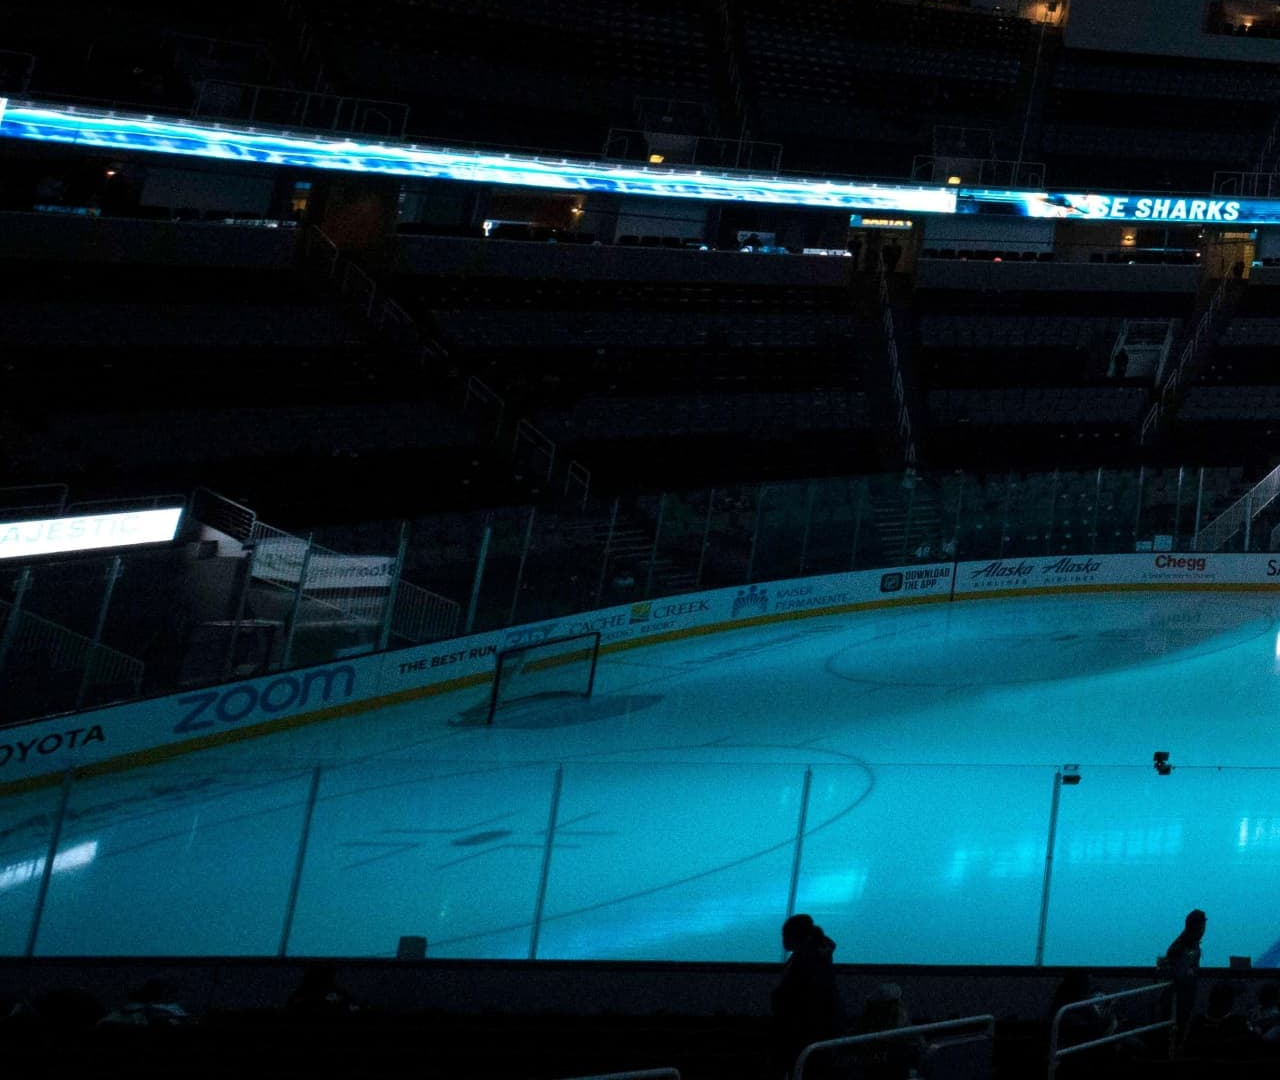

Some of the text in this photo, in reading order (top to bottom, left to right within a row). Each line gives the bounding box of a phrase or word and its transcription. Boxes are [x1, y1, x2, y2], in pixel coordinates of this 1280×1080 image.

[1136, 199, 1241, 221] SHARKS
[0, 514, 141, 542] AJESTIC
[905, 567, 951, 580] DOWNLOAD
[971, 562, 1034, 579] Alaska
[1041, 558, 1102, 574] Alaska
[1155, 555, 1206, 571] Chegg
[653, 599, 711, 619] CREEK
[399, 645, 497, 674] THE BEST RUN
[174, 663, 356, 733] zoom
[0, 725, 105, 767] OYOTA
